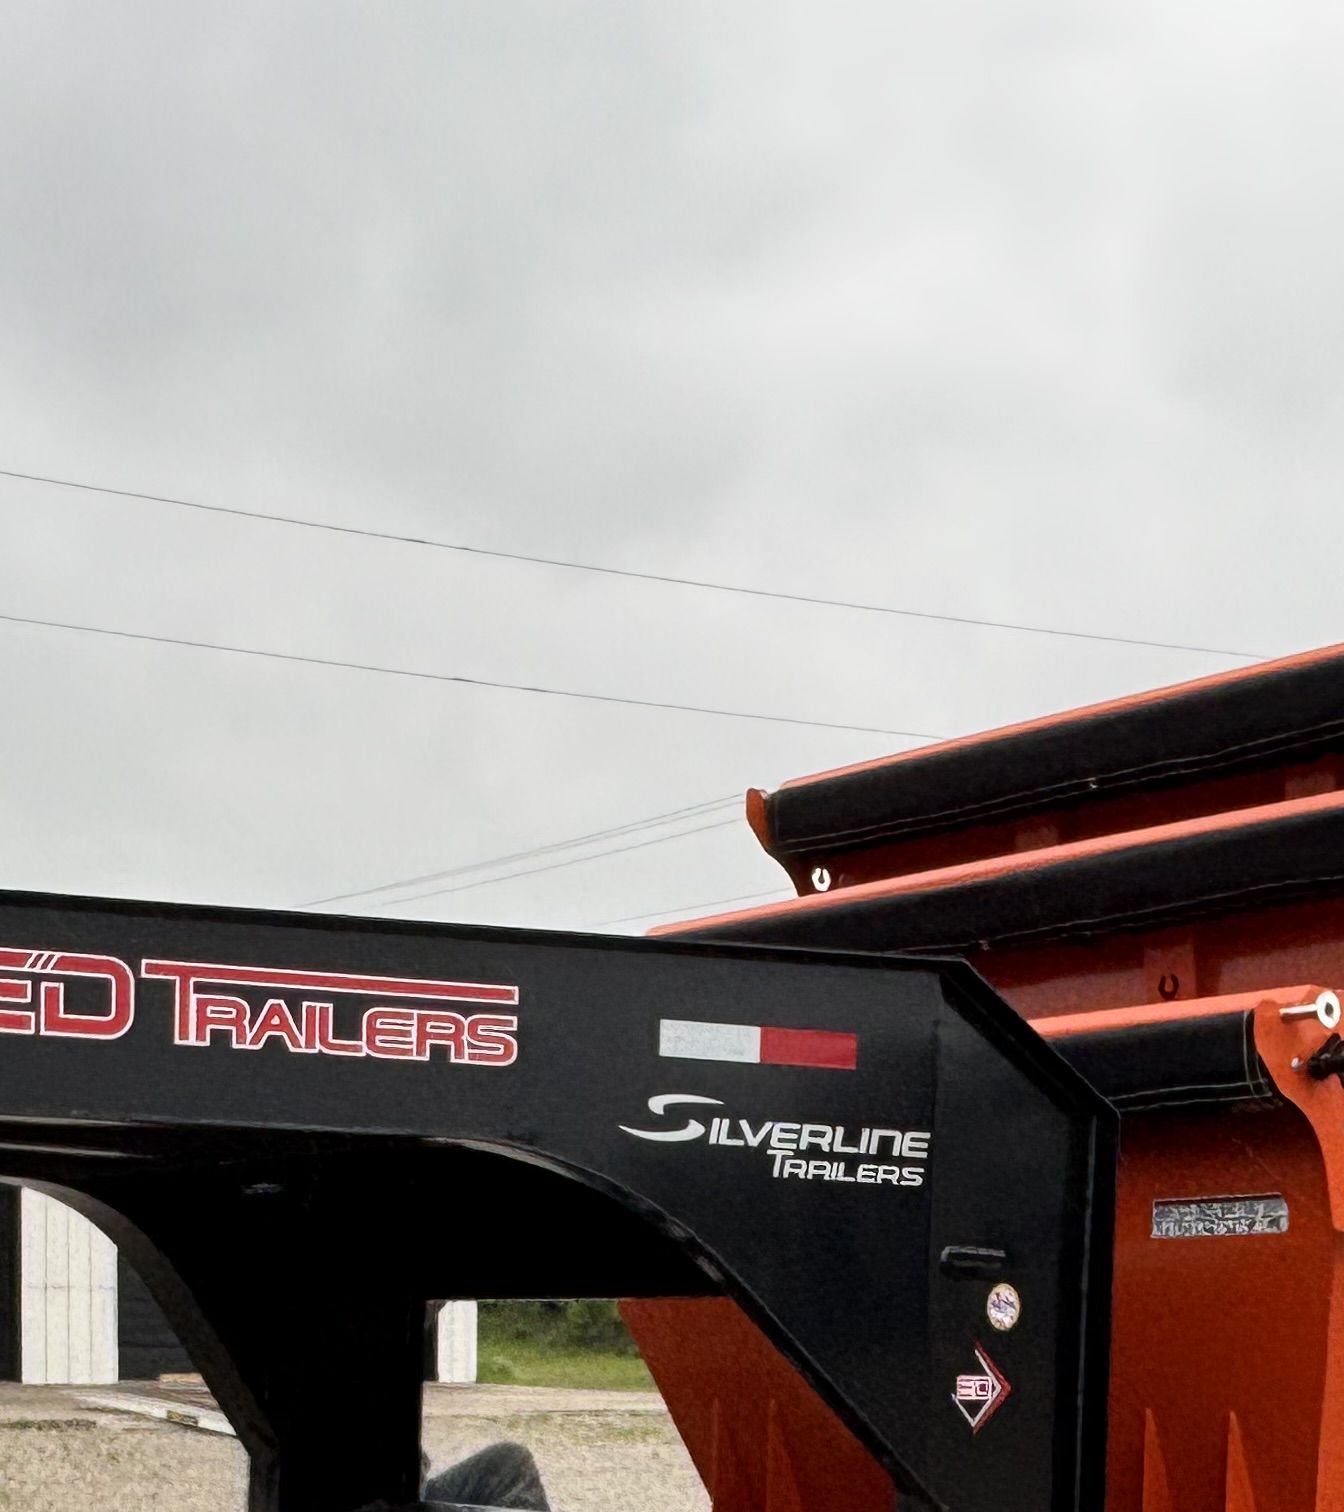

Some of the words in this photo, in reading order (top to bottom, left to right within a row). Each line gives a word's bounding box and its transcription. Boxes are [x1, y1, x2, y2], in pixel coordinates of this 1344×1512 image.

[141, 959, 519, 1067] TRAILERS
[618, 1094, 931, 1158] SILVERLINE
[767, 1150, 925, 1187] TRAILERS
